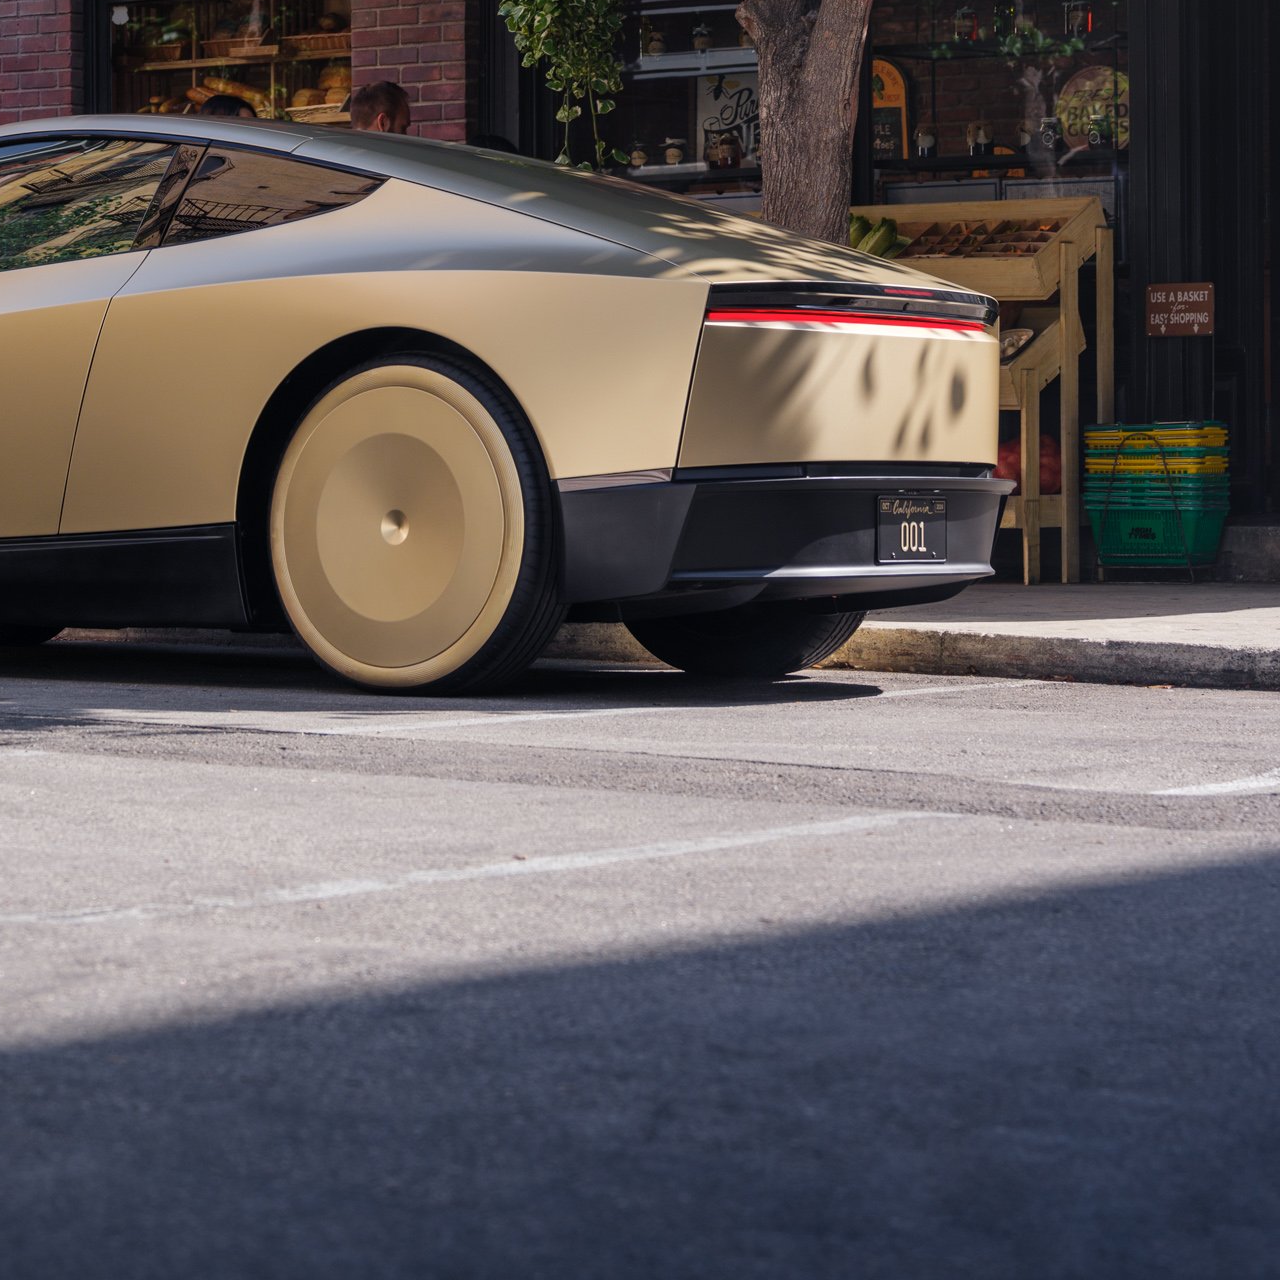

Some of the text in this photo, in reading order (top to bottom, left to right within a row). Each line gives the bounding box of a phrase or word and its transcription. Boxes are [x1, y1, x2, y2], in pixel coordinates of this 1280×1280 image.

[720, 87, 760, 126] Pur
[1151, 291, 1208, 303] USE A BASKET
[1150, 312, 1209, 325] EASY SHOPPING
[892, 499, 934, 519] California
[901, 521, 927, 552] 001
